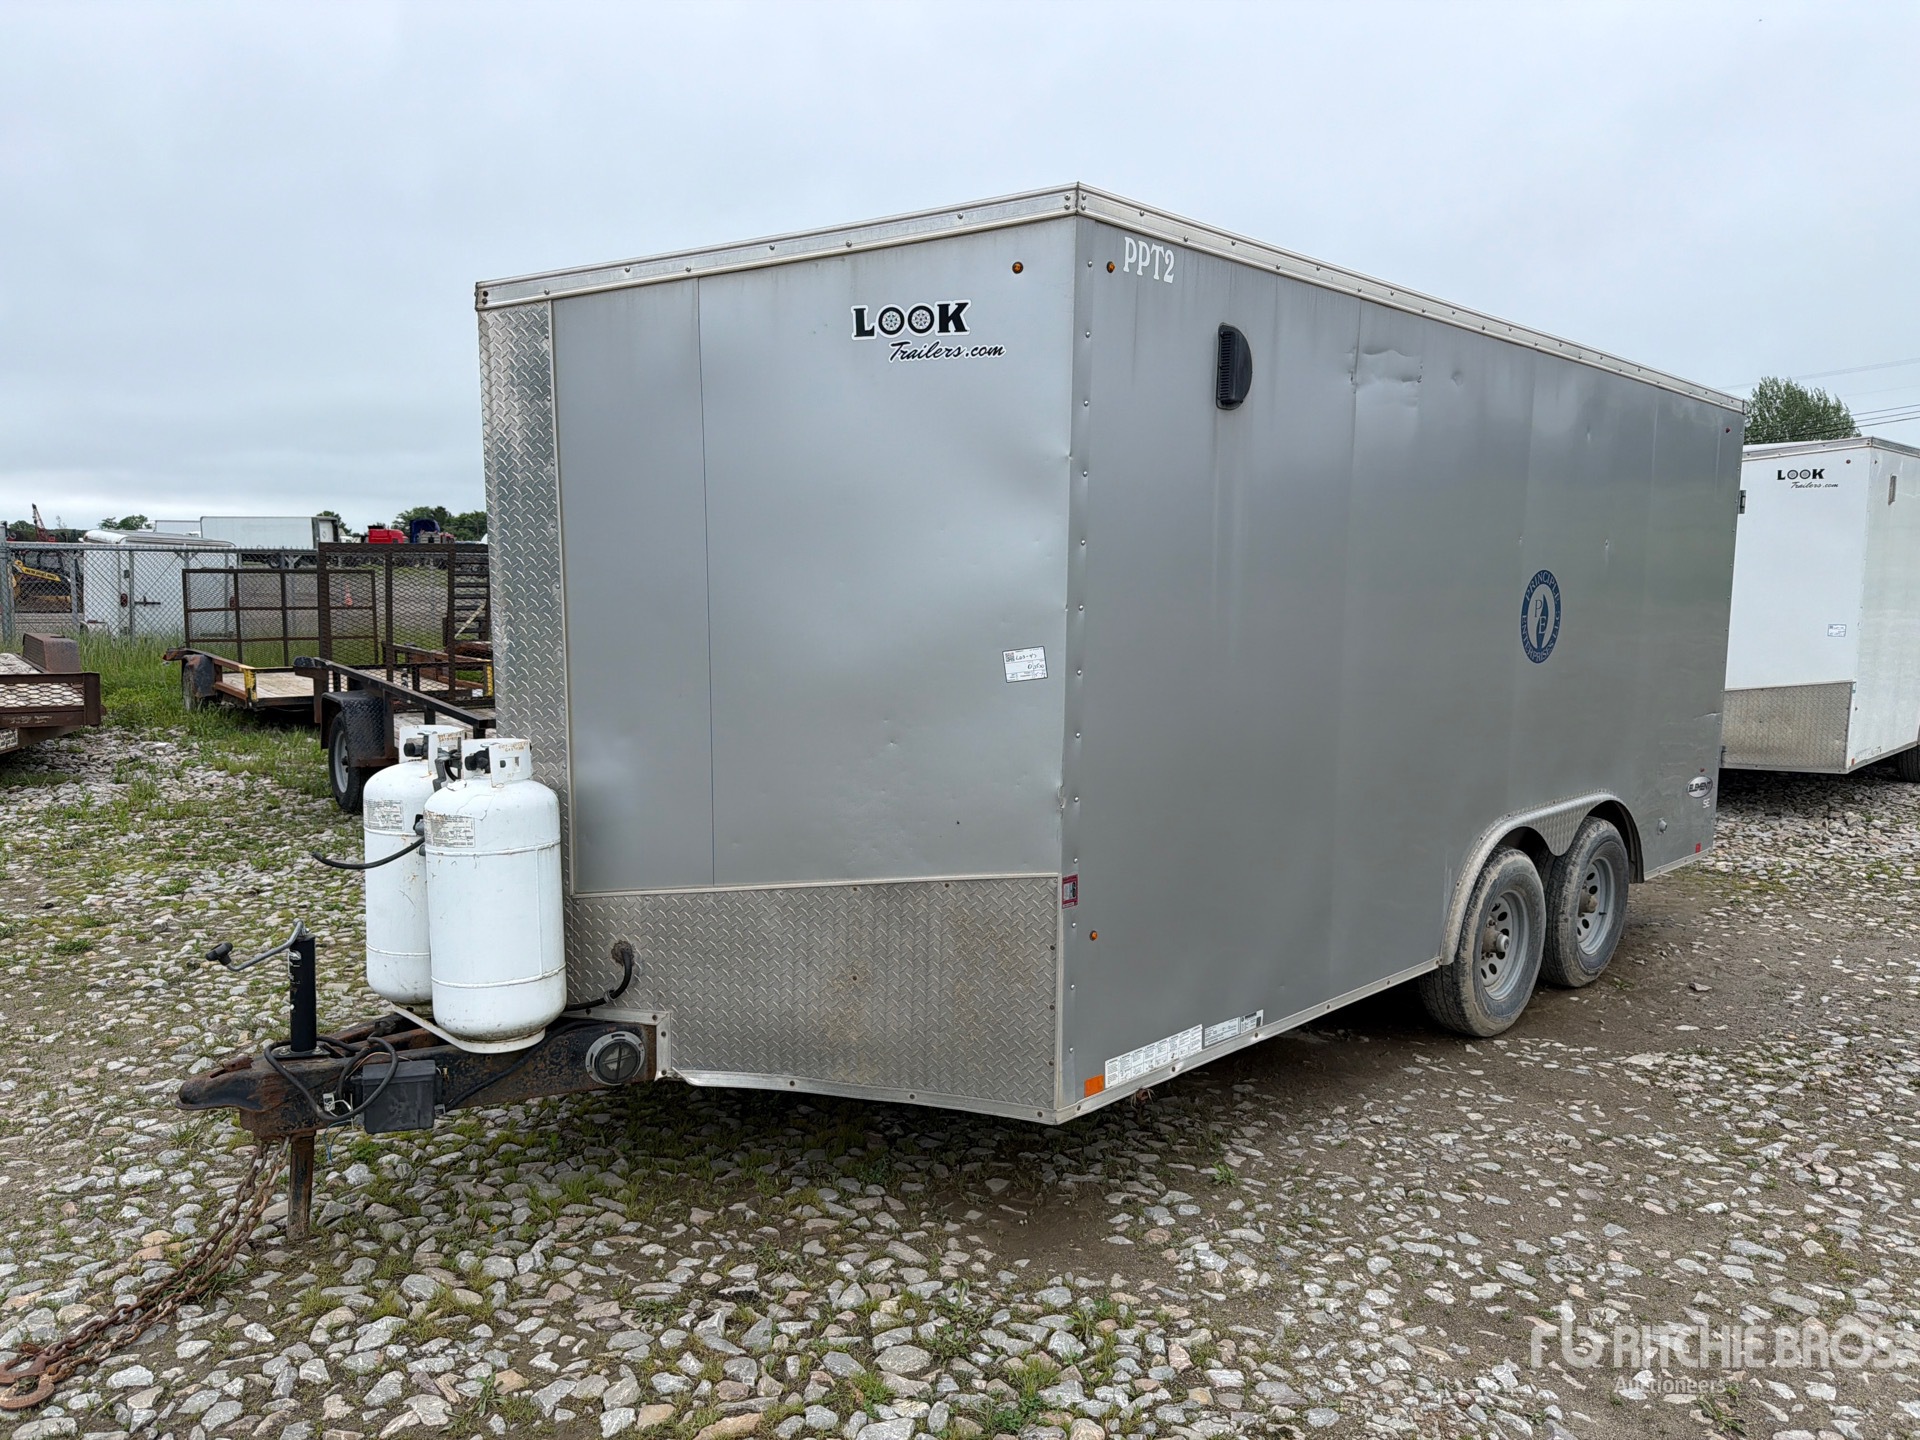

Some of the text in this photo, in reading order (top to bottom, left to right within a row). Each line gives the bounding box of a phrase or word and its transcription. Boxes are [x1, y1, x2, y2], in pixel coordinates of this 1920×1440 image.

[1123, 236, 1175, 284] PPT2
[852, 301, 970, 339] LOOK
[889, 340, 1005, 362] Trailers.com
[1776, 468, 1826, 481] LOOK
